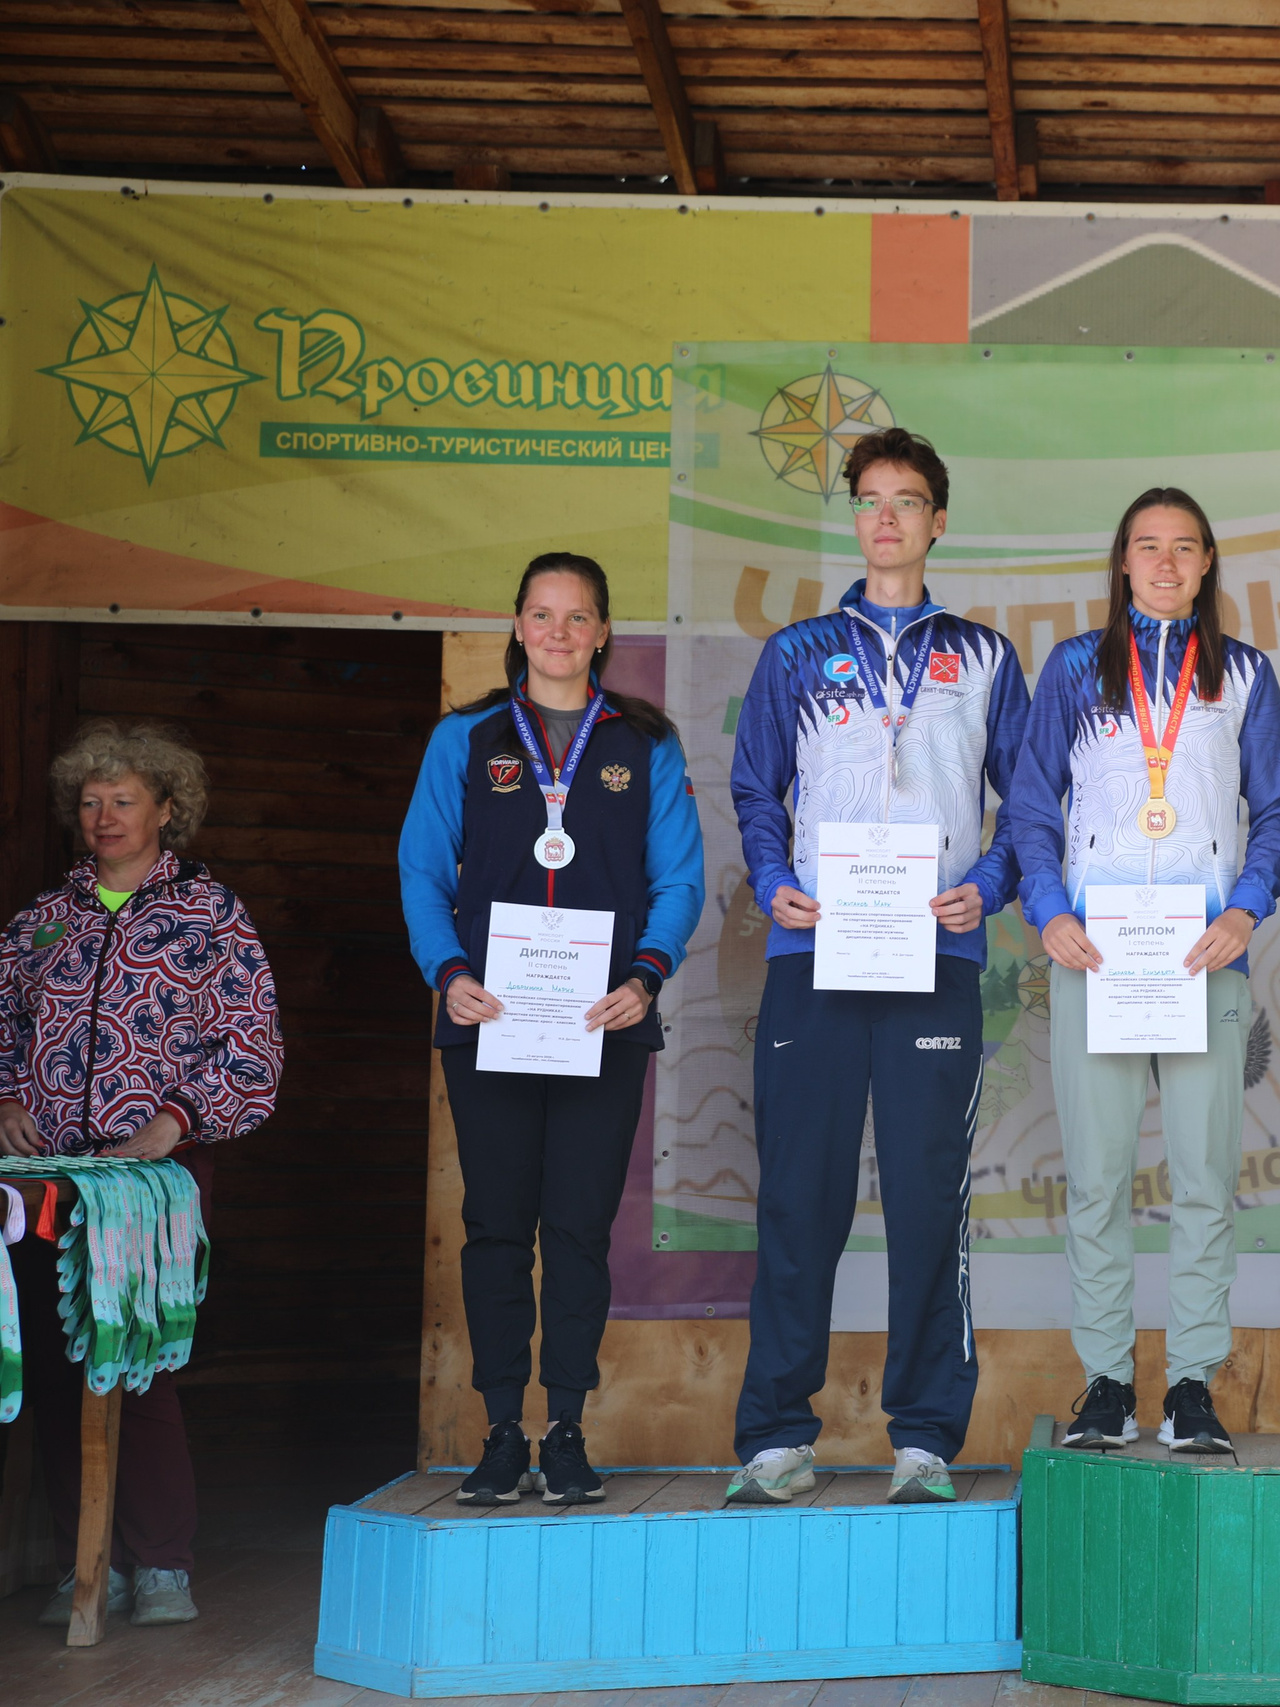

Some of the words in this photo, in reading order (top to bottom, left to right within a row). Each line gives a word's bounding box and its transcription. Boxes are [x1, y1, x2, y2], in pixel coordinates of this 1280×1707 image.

[275, 431, 623, 460] СПОРТИВНО-ТУРИСТИЧЕСКИЙ
[857, 648, 878, 696] ЧЕЛЯБИНСКАЯ
[906, 661, 923, 695] ОБЛАСТЬ
[1168, 698, 1186, 735] ОБЛАСТЬ
[566, 737, 585, 772] ОБЛАСТЬ
[849, 865, 907, 875] ДИПЛОМ
[1118, 927, 1175, 937] ДИПЛОМ
[520, 948, 579, 960] ДИПЛОМ
[526, 973, 571, 981] НАГРАЖДАЕТСЯ
